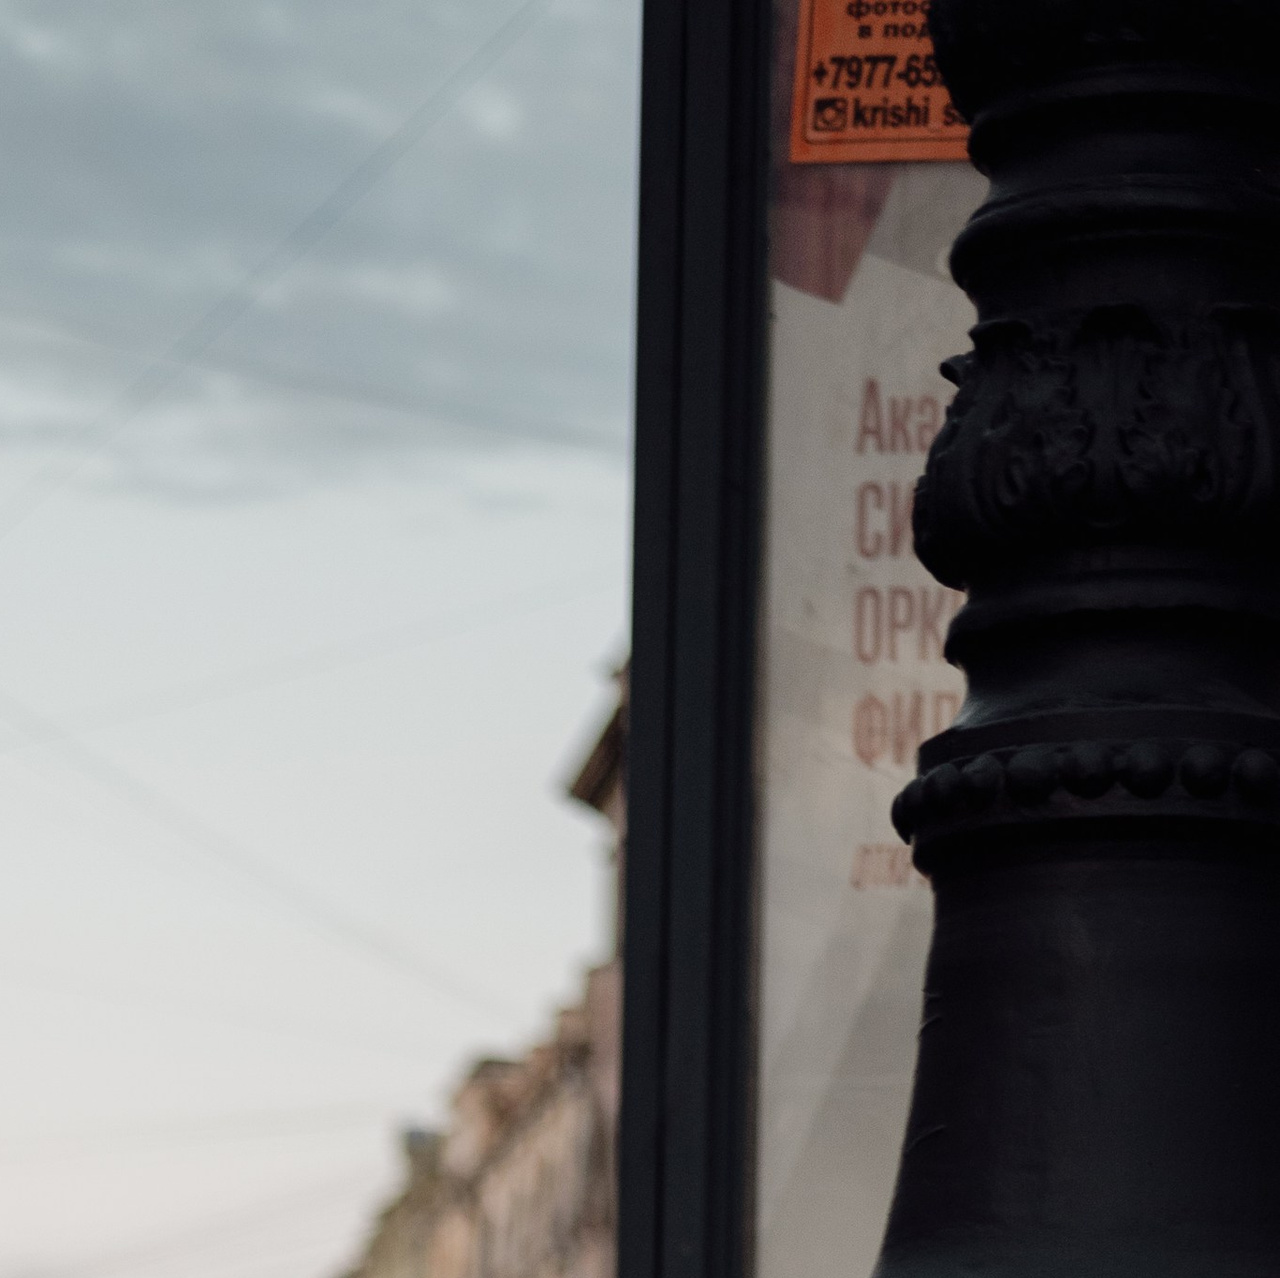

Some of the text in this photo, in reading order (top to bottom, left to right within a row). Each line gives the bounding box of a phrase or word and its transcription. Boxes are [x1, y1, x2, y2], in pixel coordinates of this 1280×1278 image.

[813, 54, 944, 89] +7977-65
[854, 376, 941, 456] Ака
[855, 481, 916, 559] СИ
[853, 585, 956, 664] ОРК
